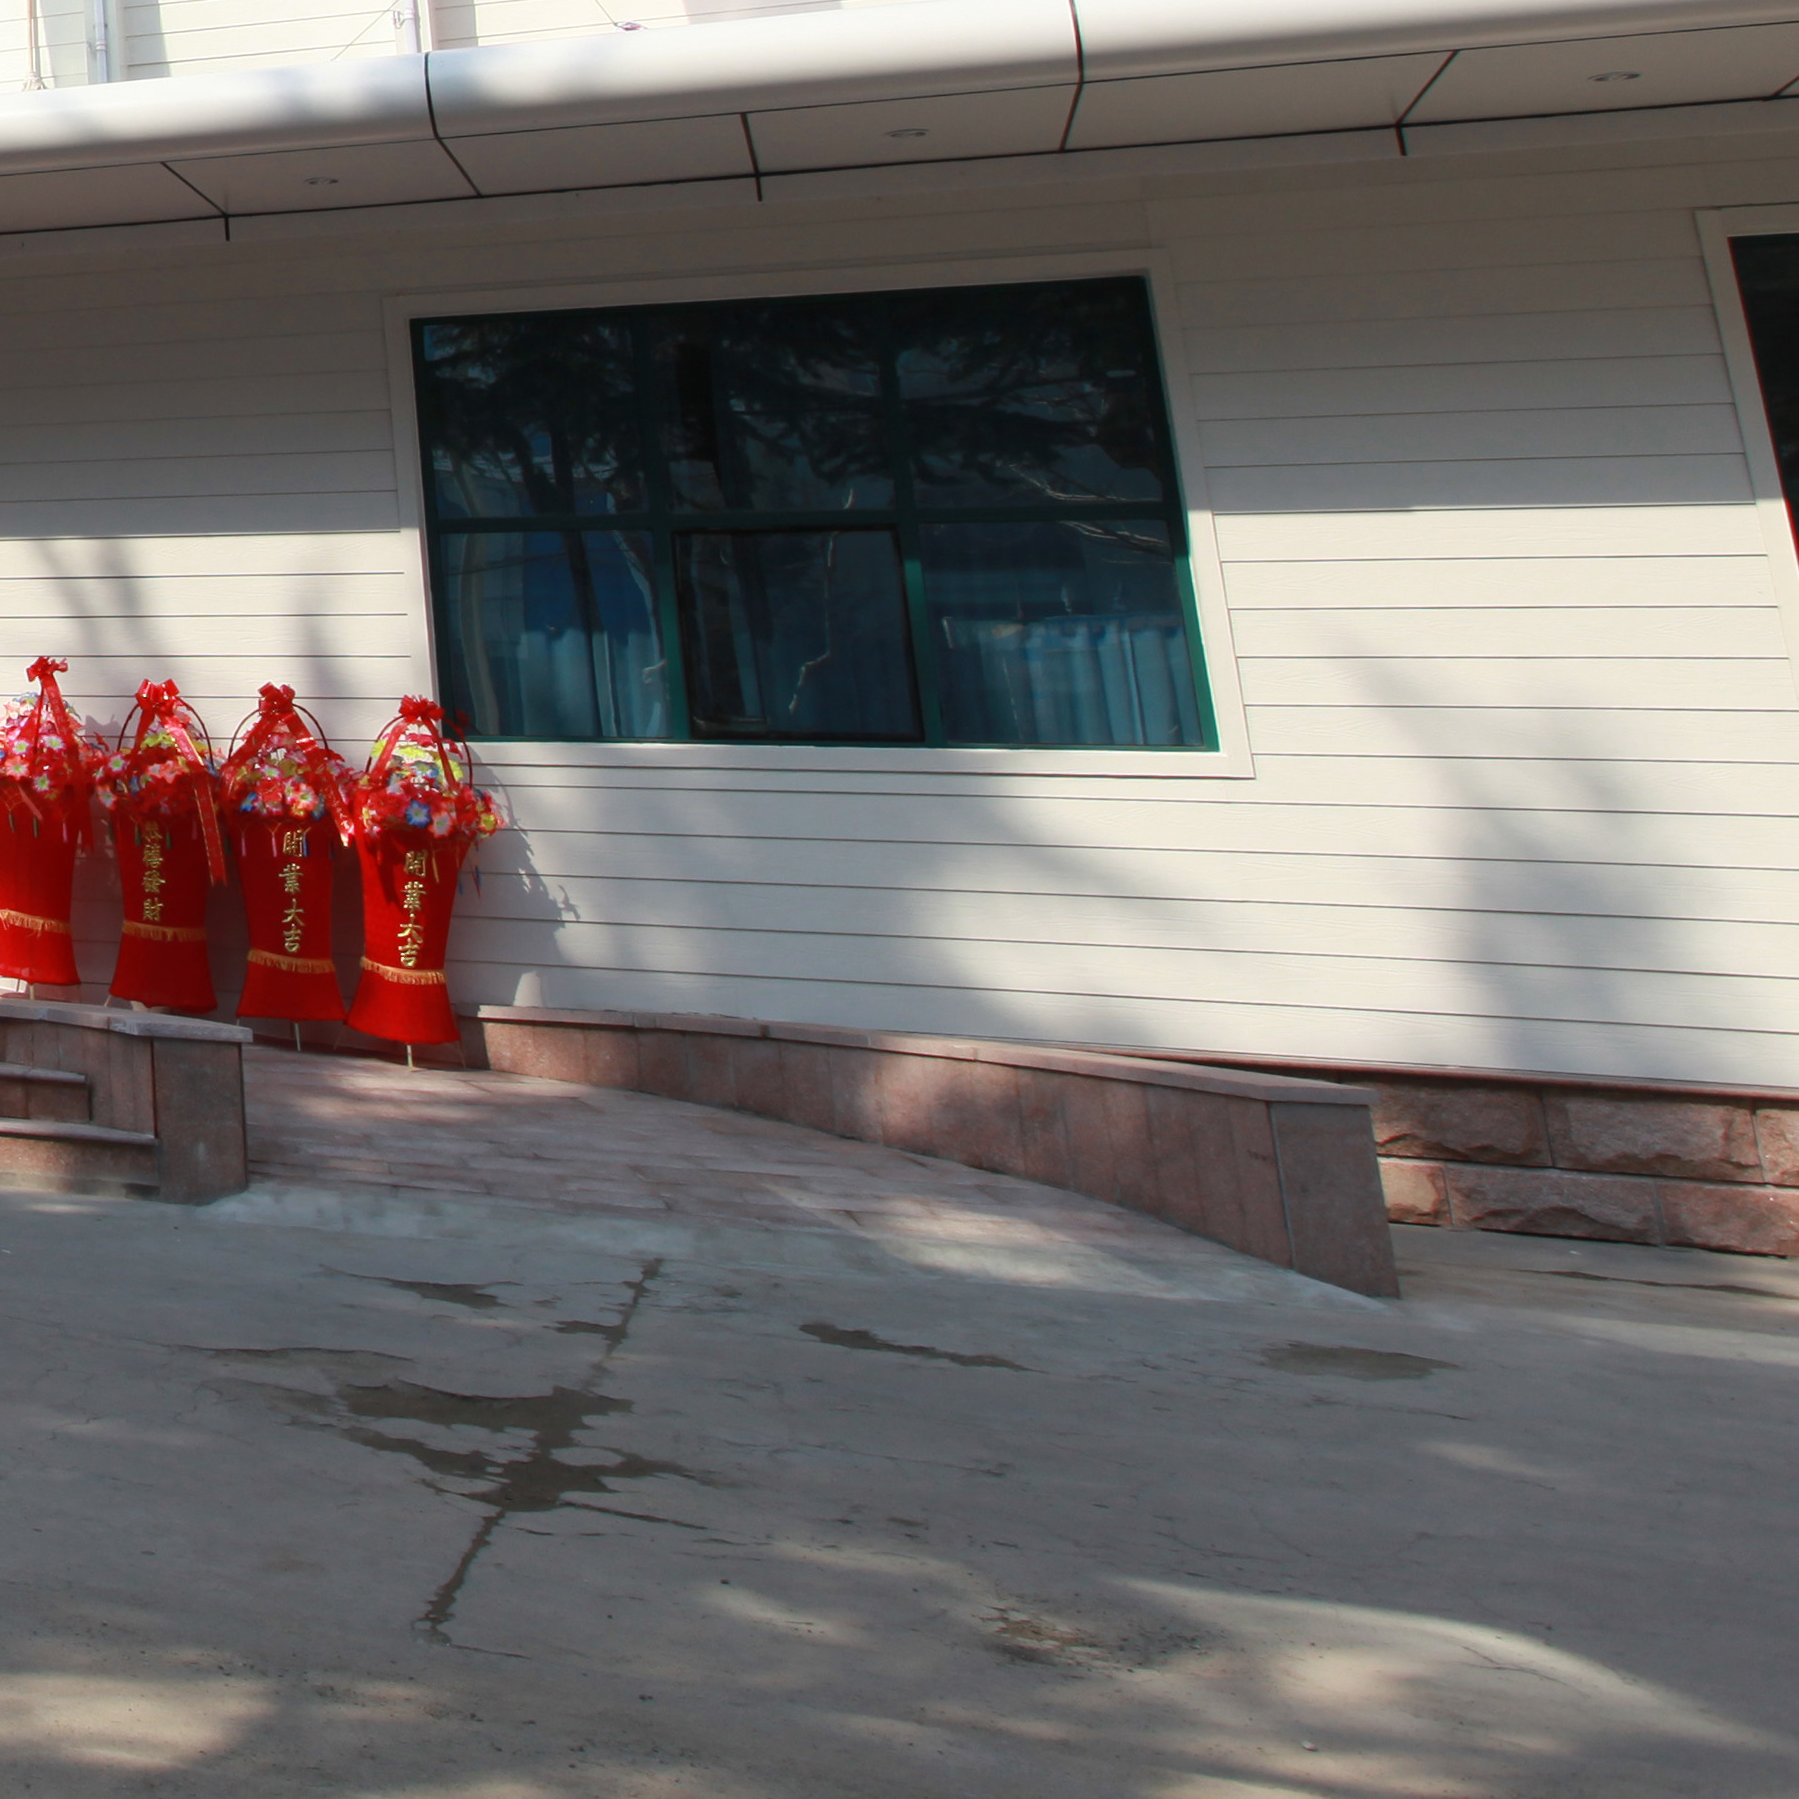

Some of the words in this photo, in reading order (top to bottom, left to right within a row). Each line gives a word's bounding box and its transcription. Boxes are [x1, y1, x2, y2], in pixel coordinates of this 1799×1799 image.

[278, 829, 305, 953] 開業大吉
[396, 850, 428, 968] 開業大吉
